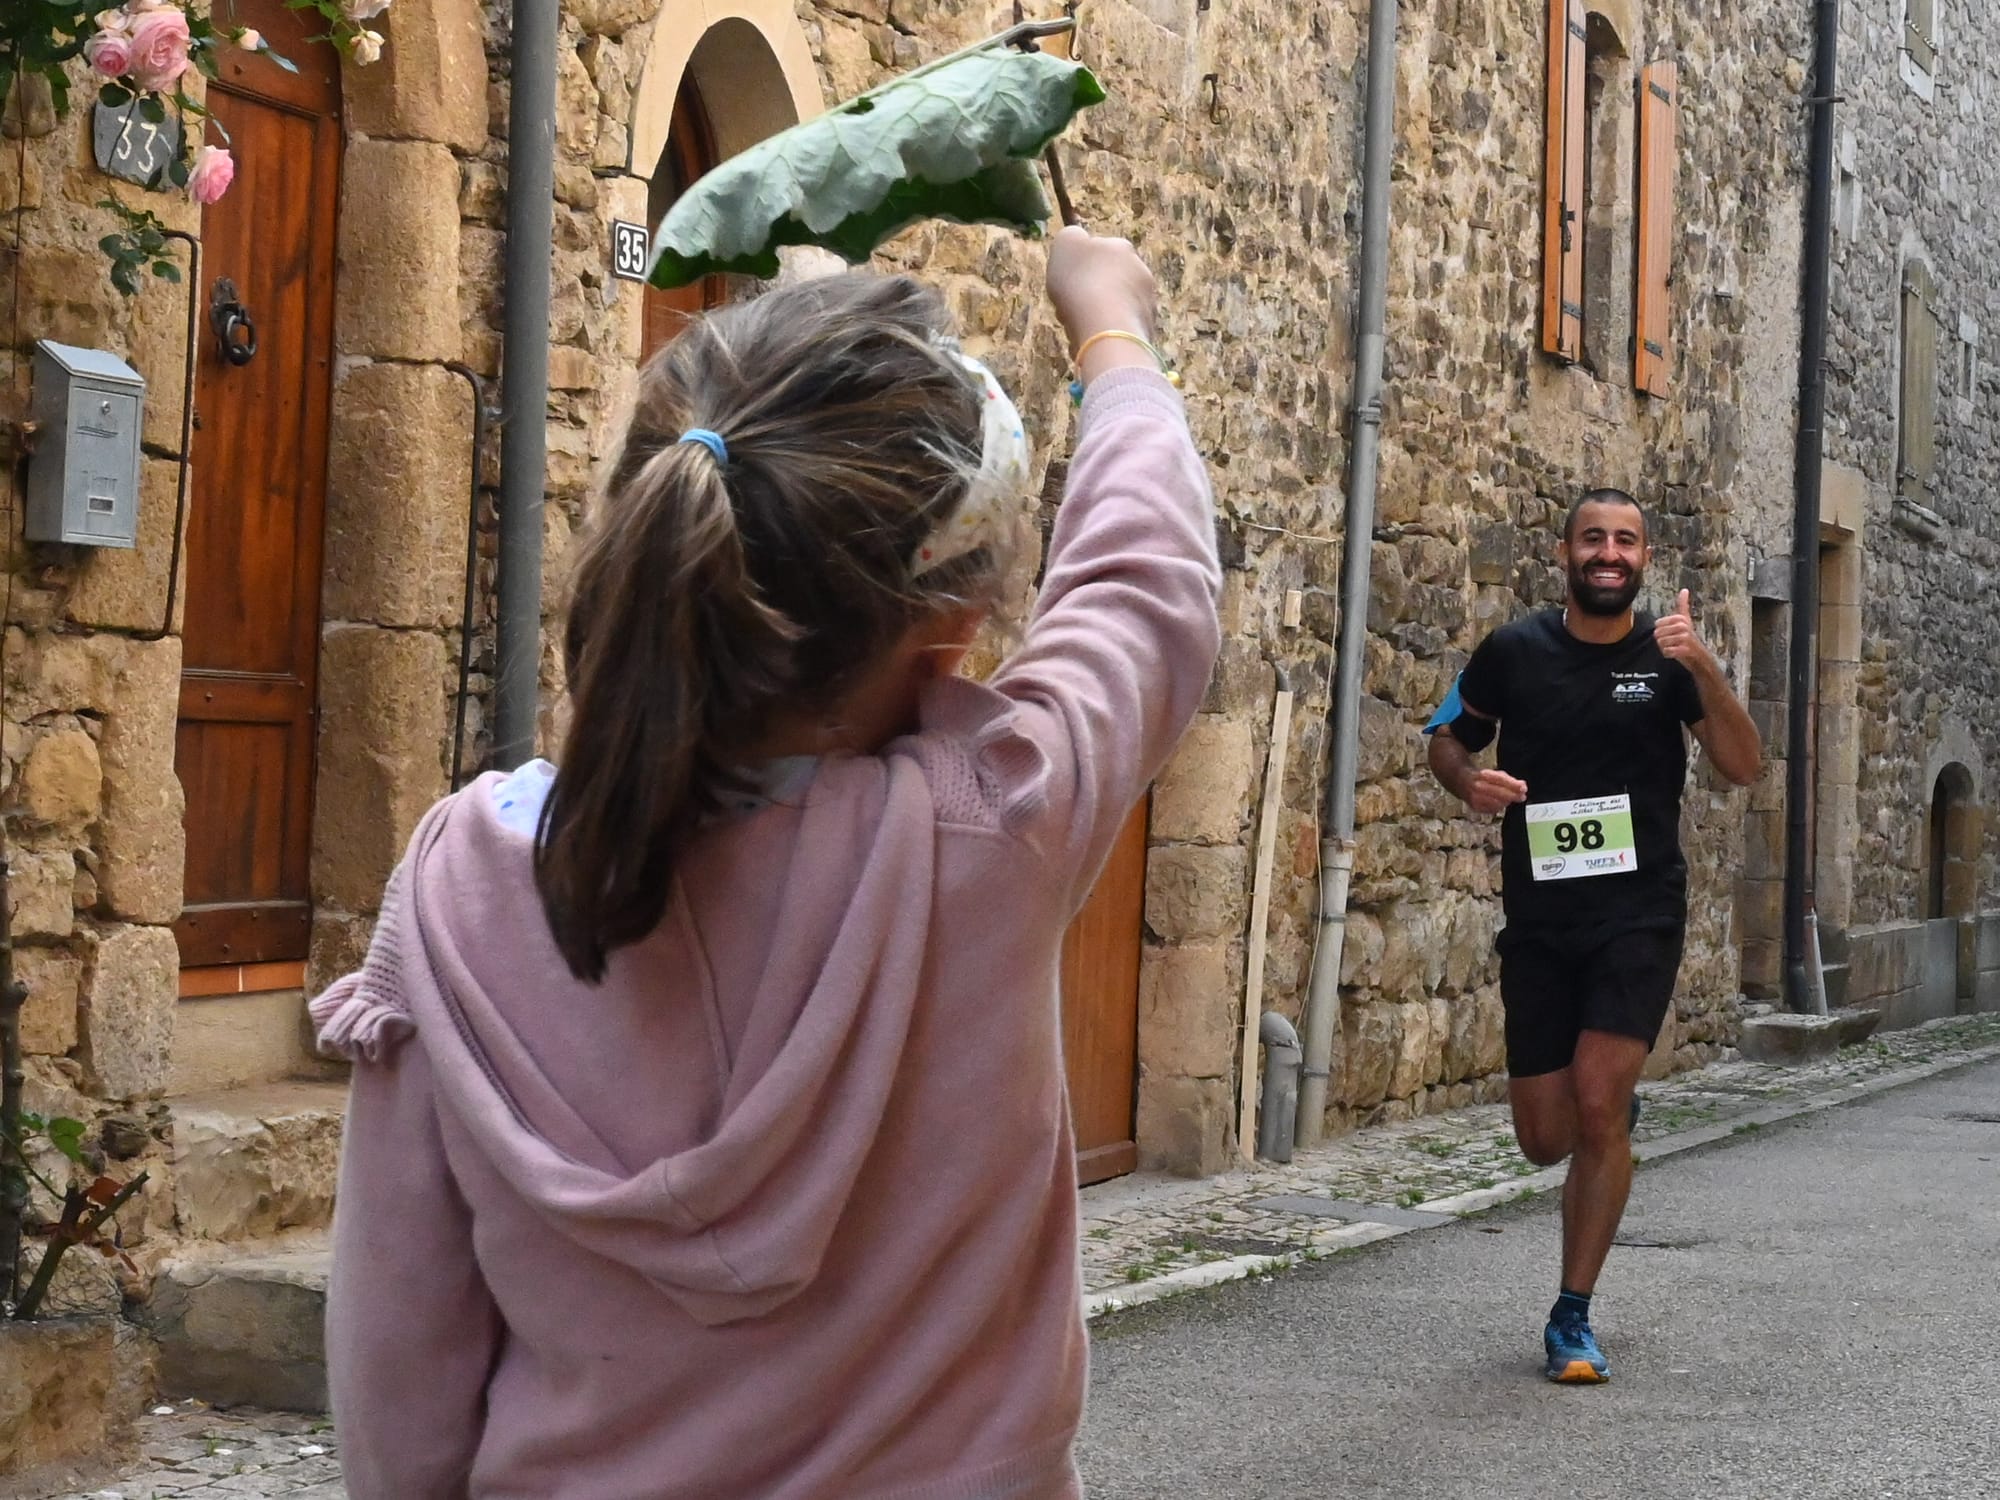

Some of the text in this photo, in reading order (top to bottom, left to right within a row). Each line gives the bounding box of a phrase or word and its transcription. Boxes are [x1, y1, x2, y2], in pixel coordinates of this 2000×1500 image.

[117, 115, 157, 173] 33
[619, 229, 644, 273] 35
[1554, 819, 1605, 853] 98
